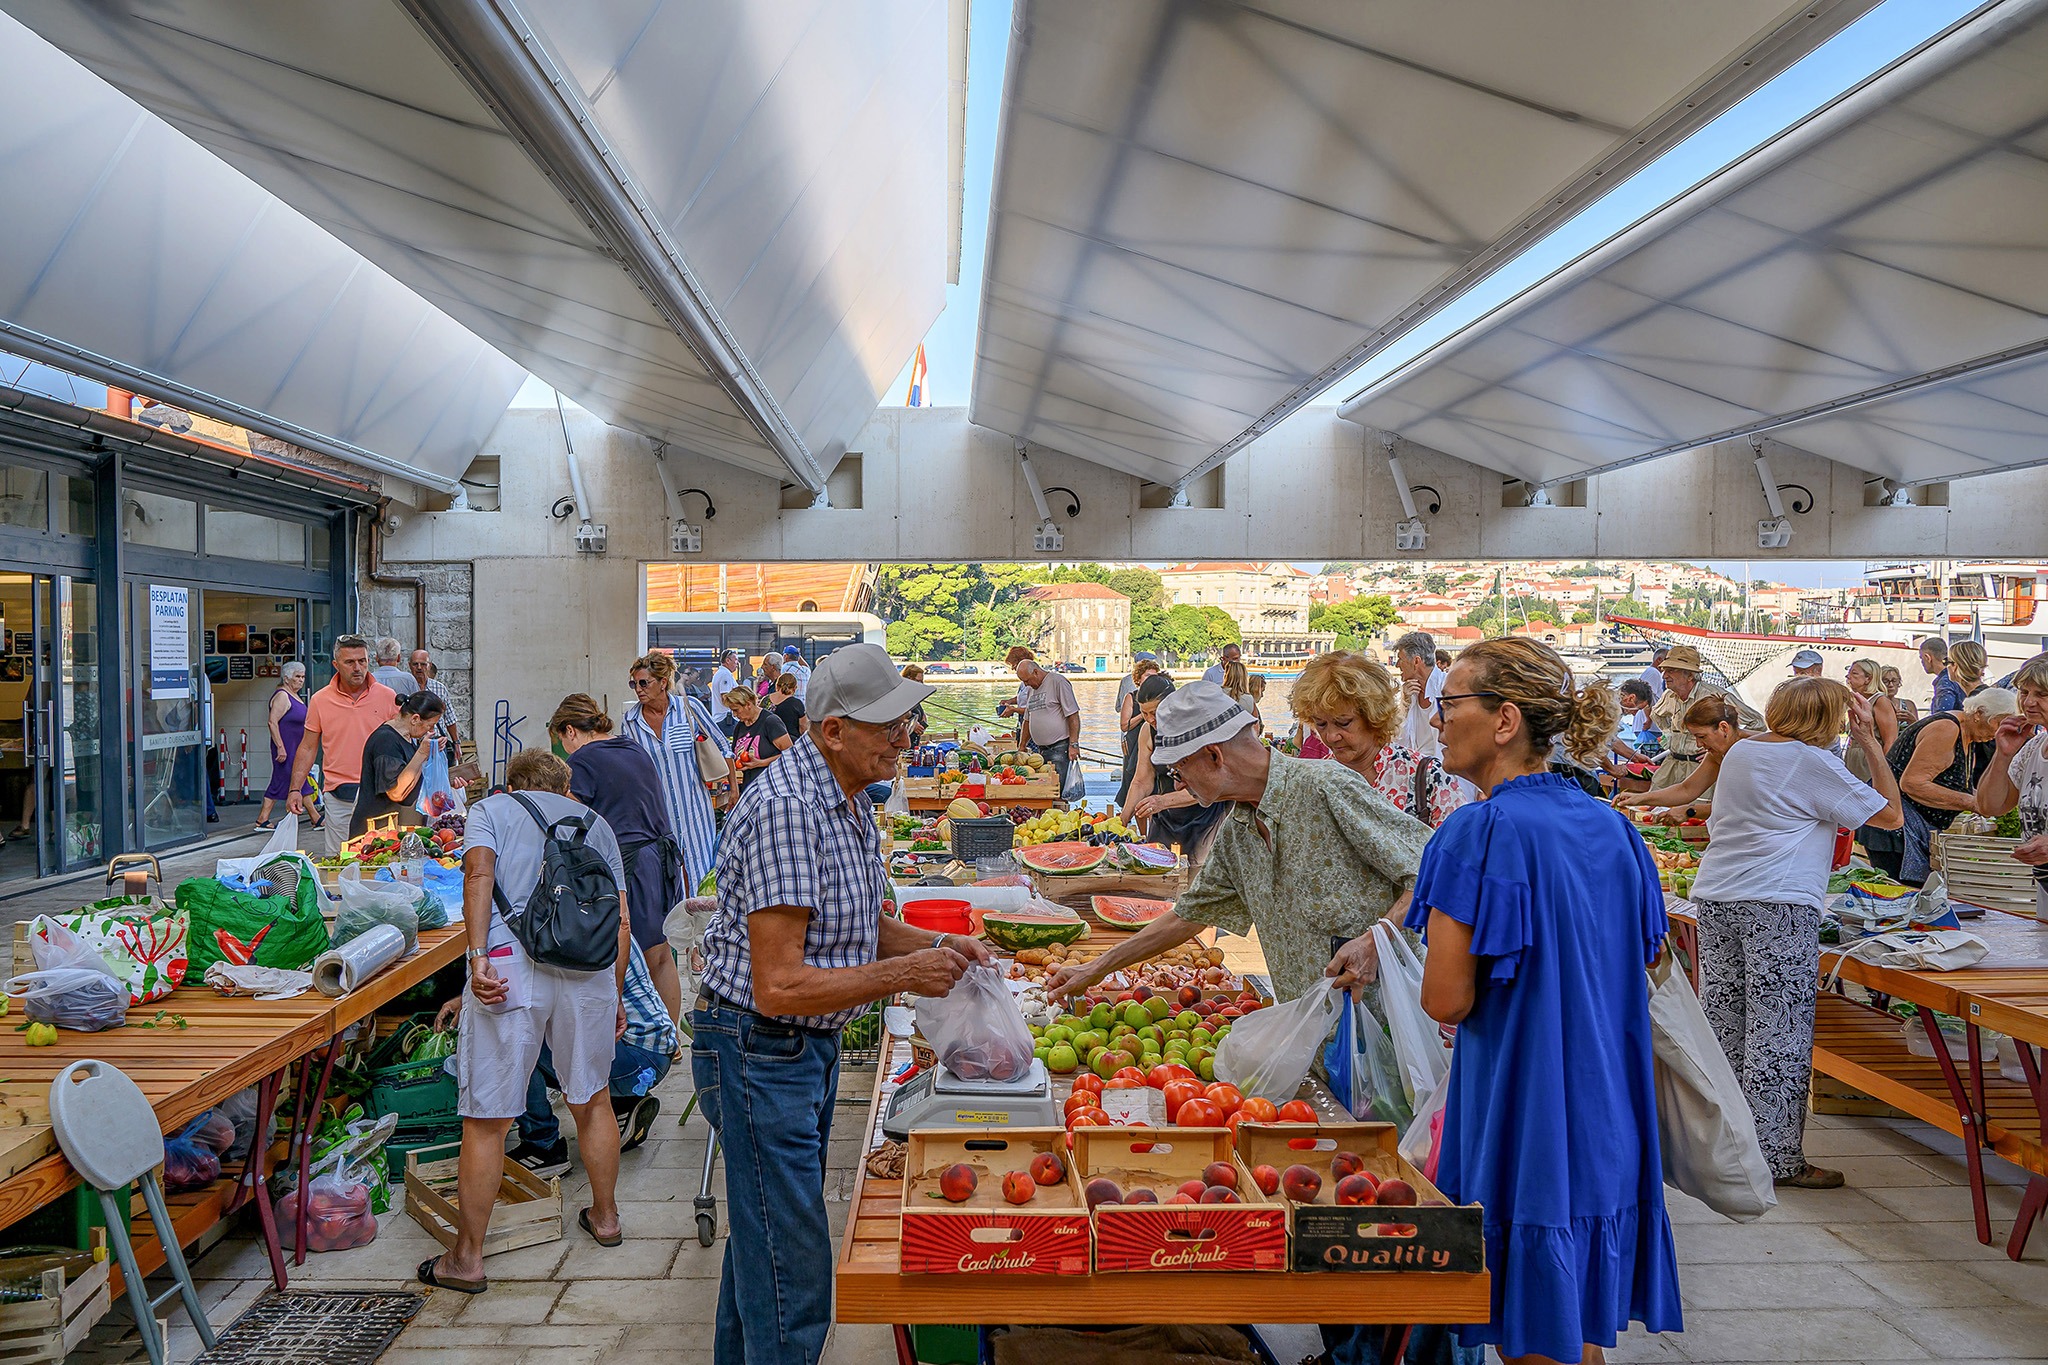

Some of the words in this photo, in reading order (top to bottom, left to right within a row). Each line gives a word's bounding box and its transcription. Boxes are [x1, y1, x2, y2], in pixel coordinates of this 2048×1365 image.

[151, 590, 187, 603] BESPLATAN
[155, 604, 185, 617] PARKING
[1809, 644, 1858, 652] VOYAGE
[1054, 1224, 1079, 1234] alm
[1246, 1218, 1271, 1228] alm
[957, 1251, 1036, 1272] Cachirulo
[1150, 1245, 1229, 1267] Cachirulo
[1323, 1244, 1450, 1268] Quality
